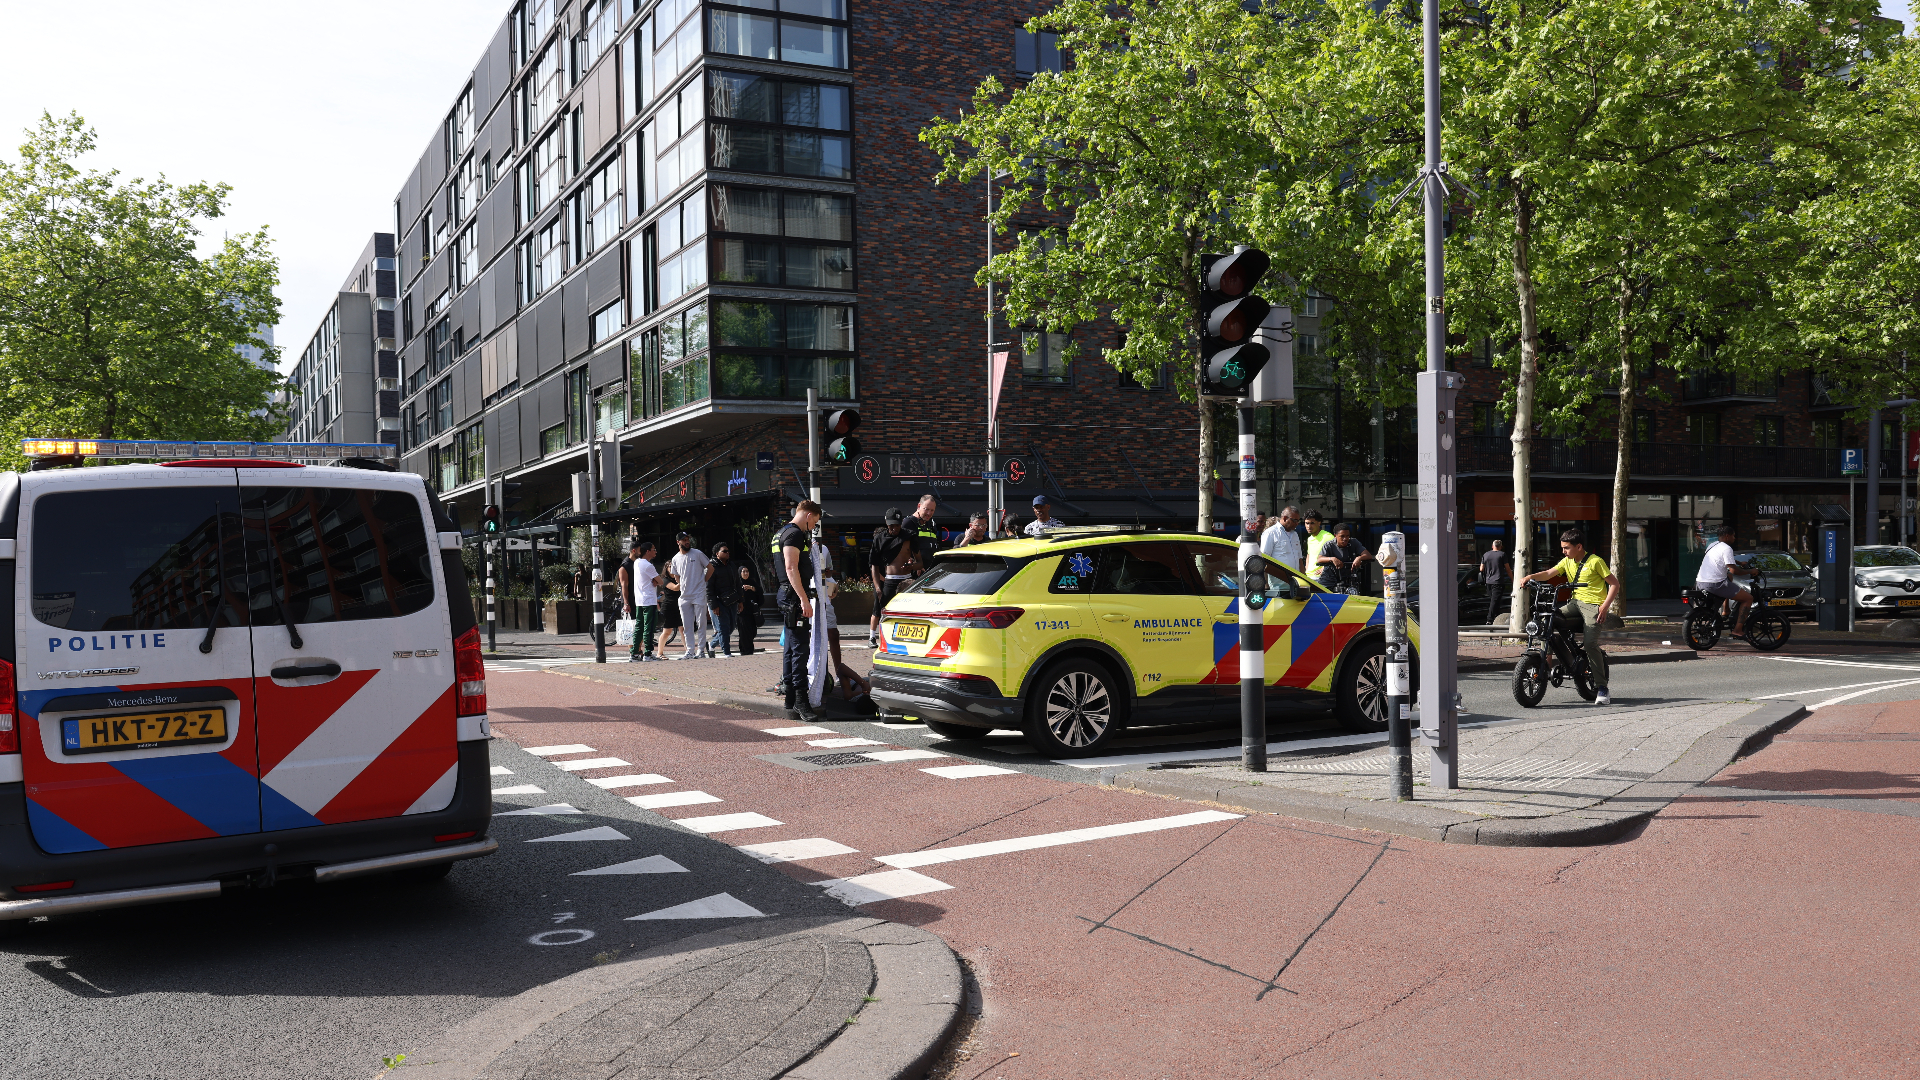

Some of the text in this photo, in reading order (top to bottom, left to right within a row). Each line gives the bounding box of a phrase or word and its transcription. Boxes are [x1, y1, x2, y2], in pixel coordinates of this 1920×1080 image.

[1846, 449, 1856, 462] P
[1758, 505, 1794, 515] SAMSUNG
[1057, 575, 1079, 586] ARR
[1034, 620, 1070, 631] 17-341
[1133, 618, 1203, 628] AMBULANCE
[48, 632, 167, 653] POLITIE
[36, 667, 137, 680] VITO TOURER
[107, 694, 178, 708] Mercedes-Benz
[91, 713, 214, 744] HKT-72-Z
[66, 737, 78, 745] NL
